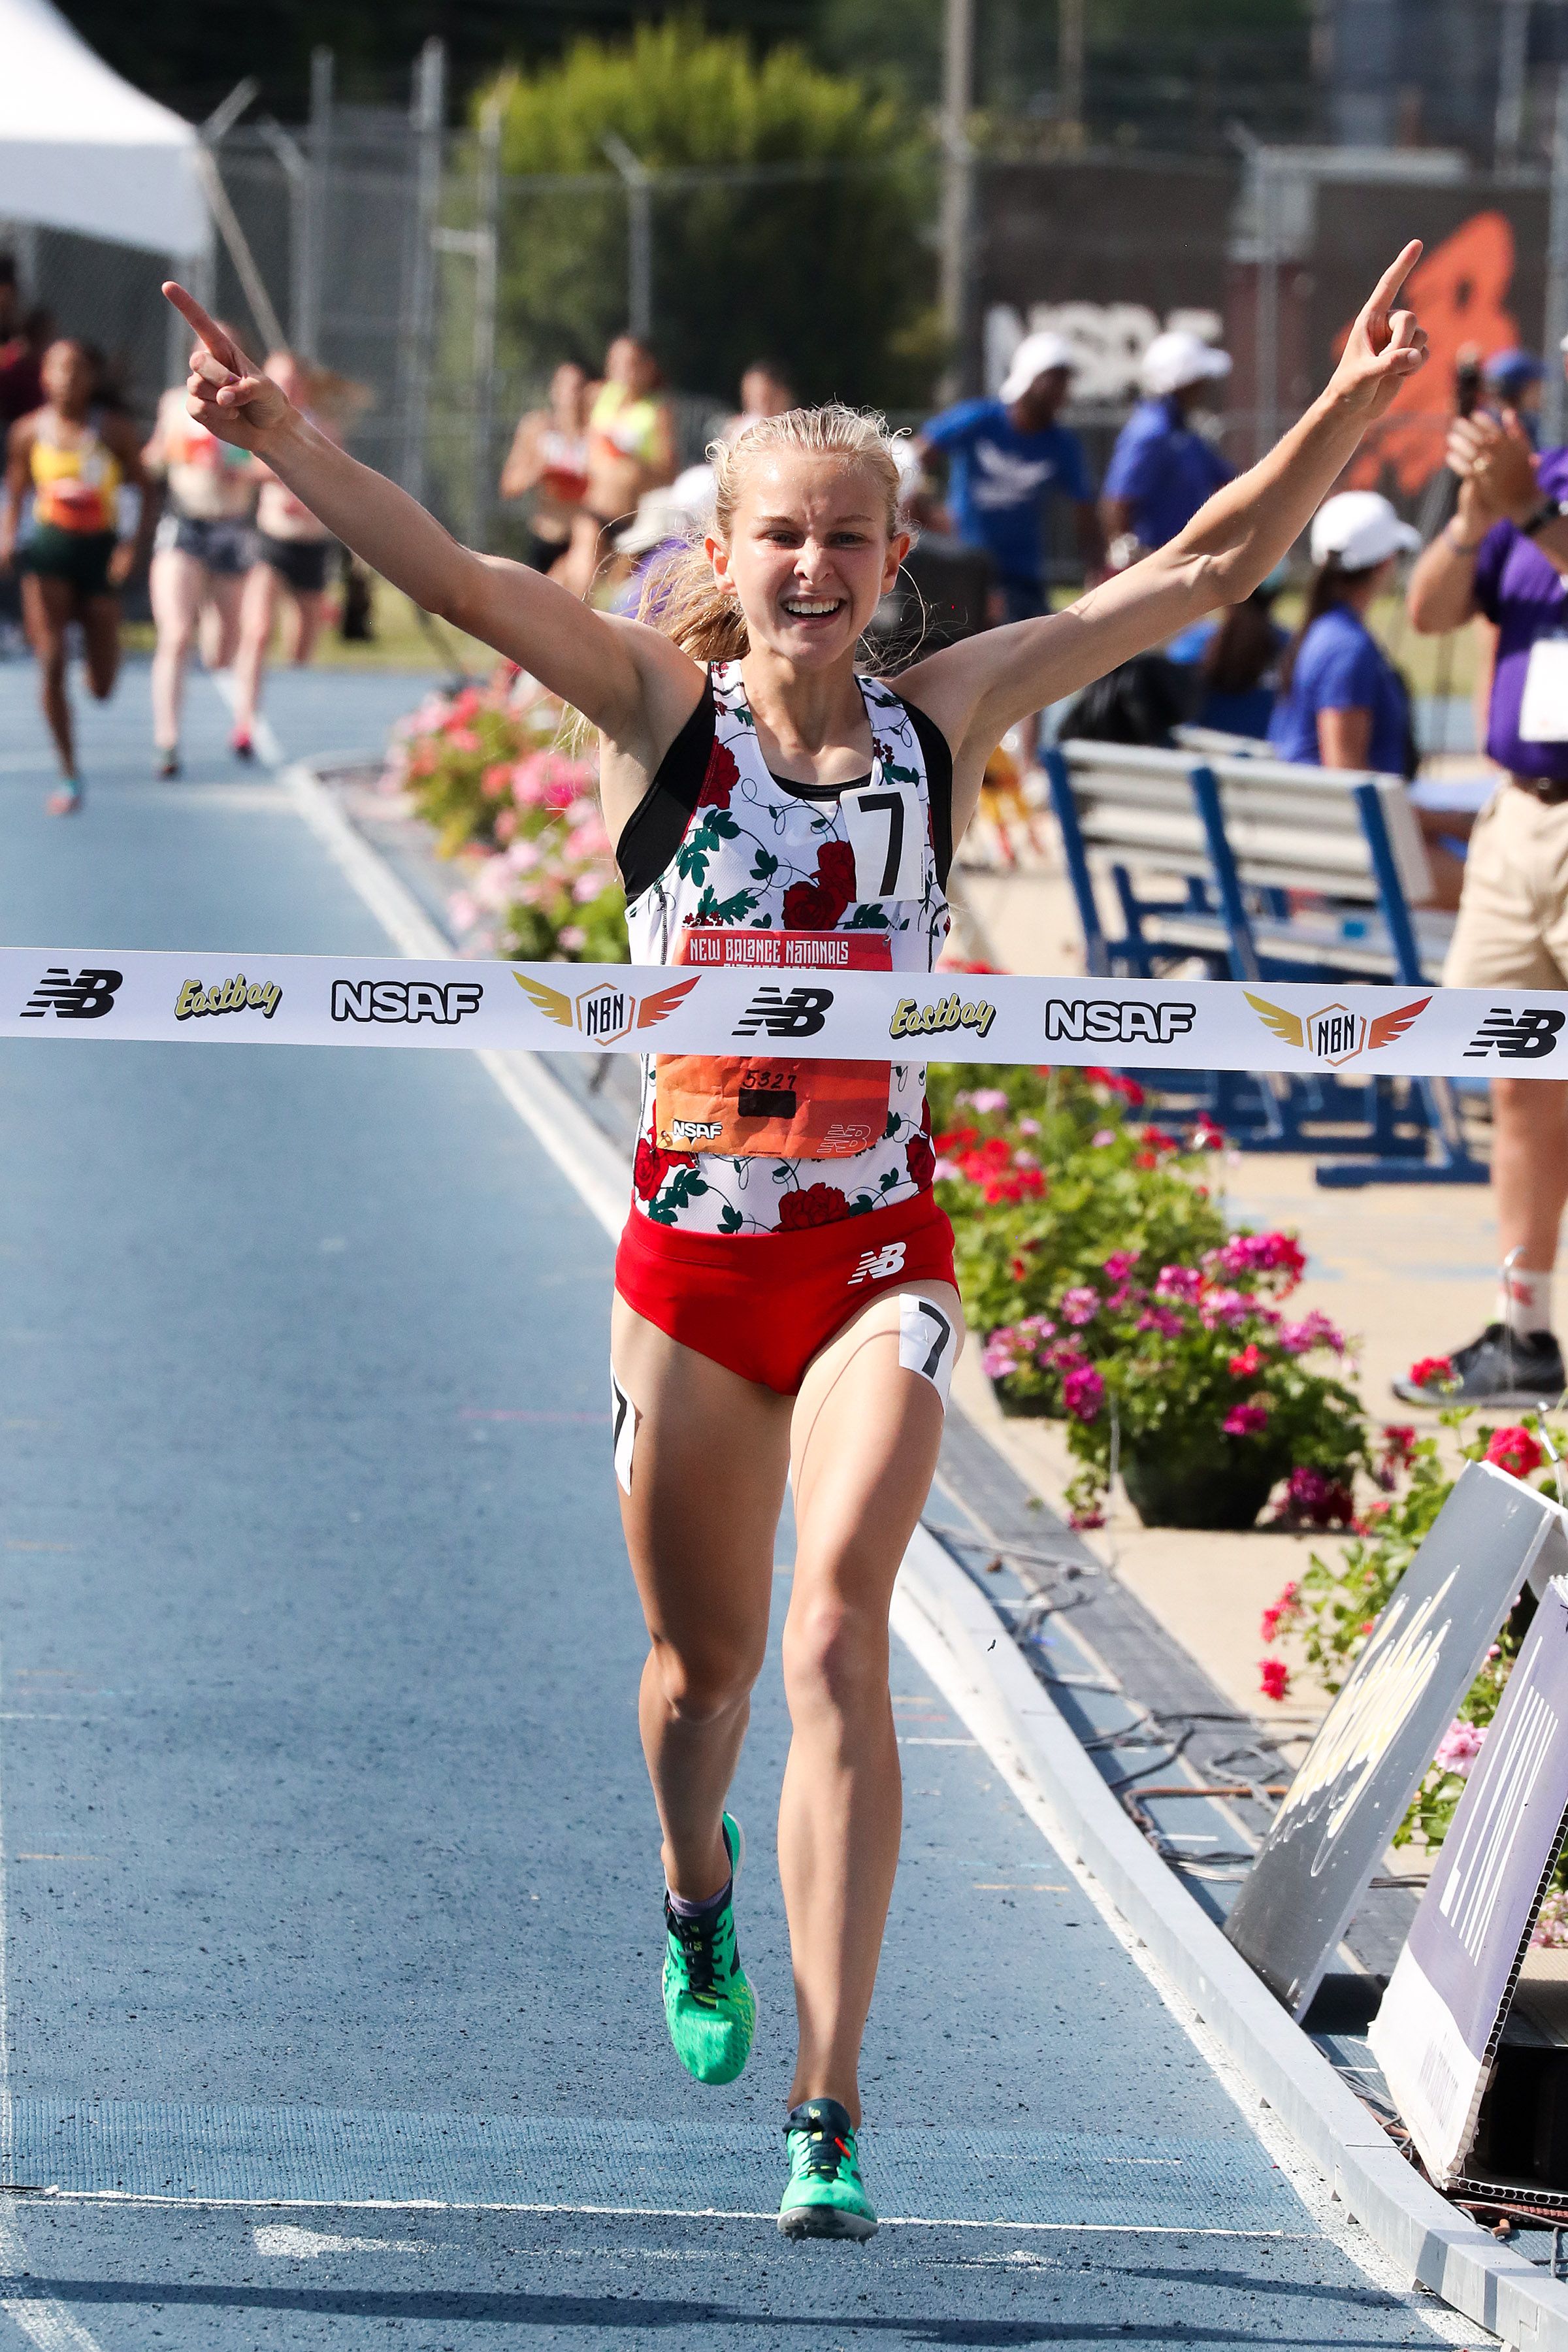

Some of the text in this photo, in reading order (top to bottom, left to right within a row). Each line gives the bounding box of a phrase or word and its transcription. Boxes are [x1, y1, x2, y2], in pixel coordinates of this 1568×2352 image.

[857, 792, 904, 896] 7
[690, 938, 849, 965] NEW BALANCE NATIONALS
[20, 968, 123, 1019] NB
[174, 973, 282, 1021] Eastbay
[331, 980, 483, 1024] NSAF
[585, 993, 624, 1037] NBN
[731, 987, 834, 1037] NB
[889, 992, 997, 1040] Eastbay
[1045, 999, 1196, 1043] NSAF
[1317, 1013, 1356, 1057] NBN
[1463, 1007, 1566, 1058] NB
[742, 1070, 797, 1090] 5327
[672, 1119, 723, 1139] NSAF
[847, 1241, 907, 1285] NB
[919, 1301, 951, 1380] 7
